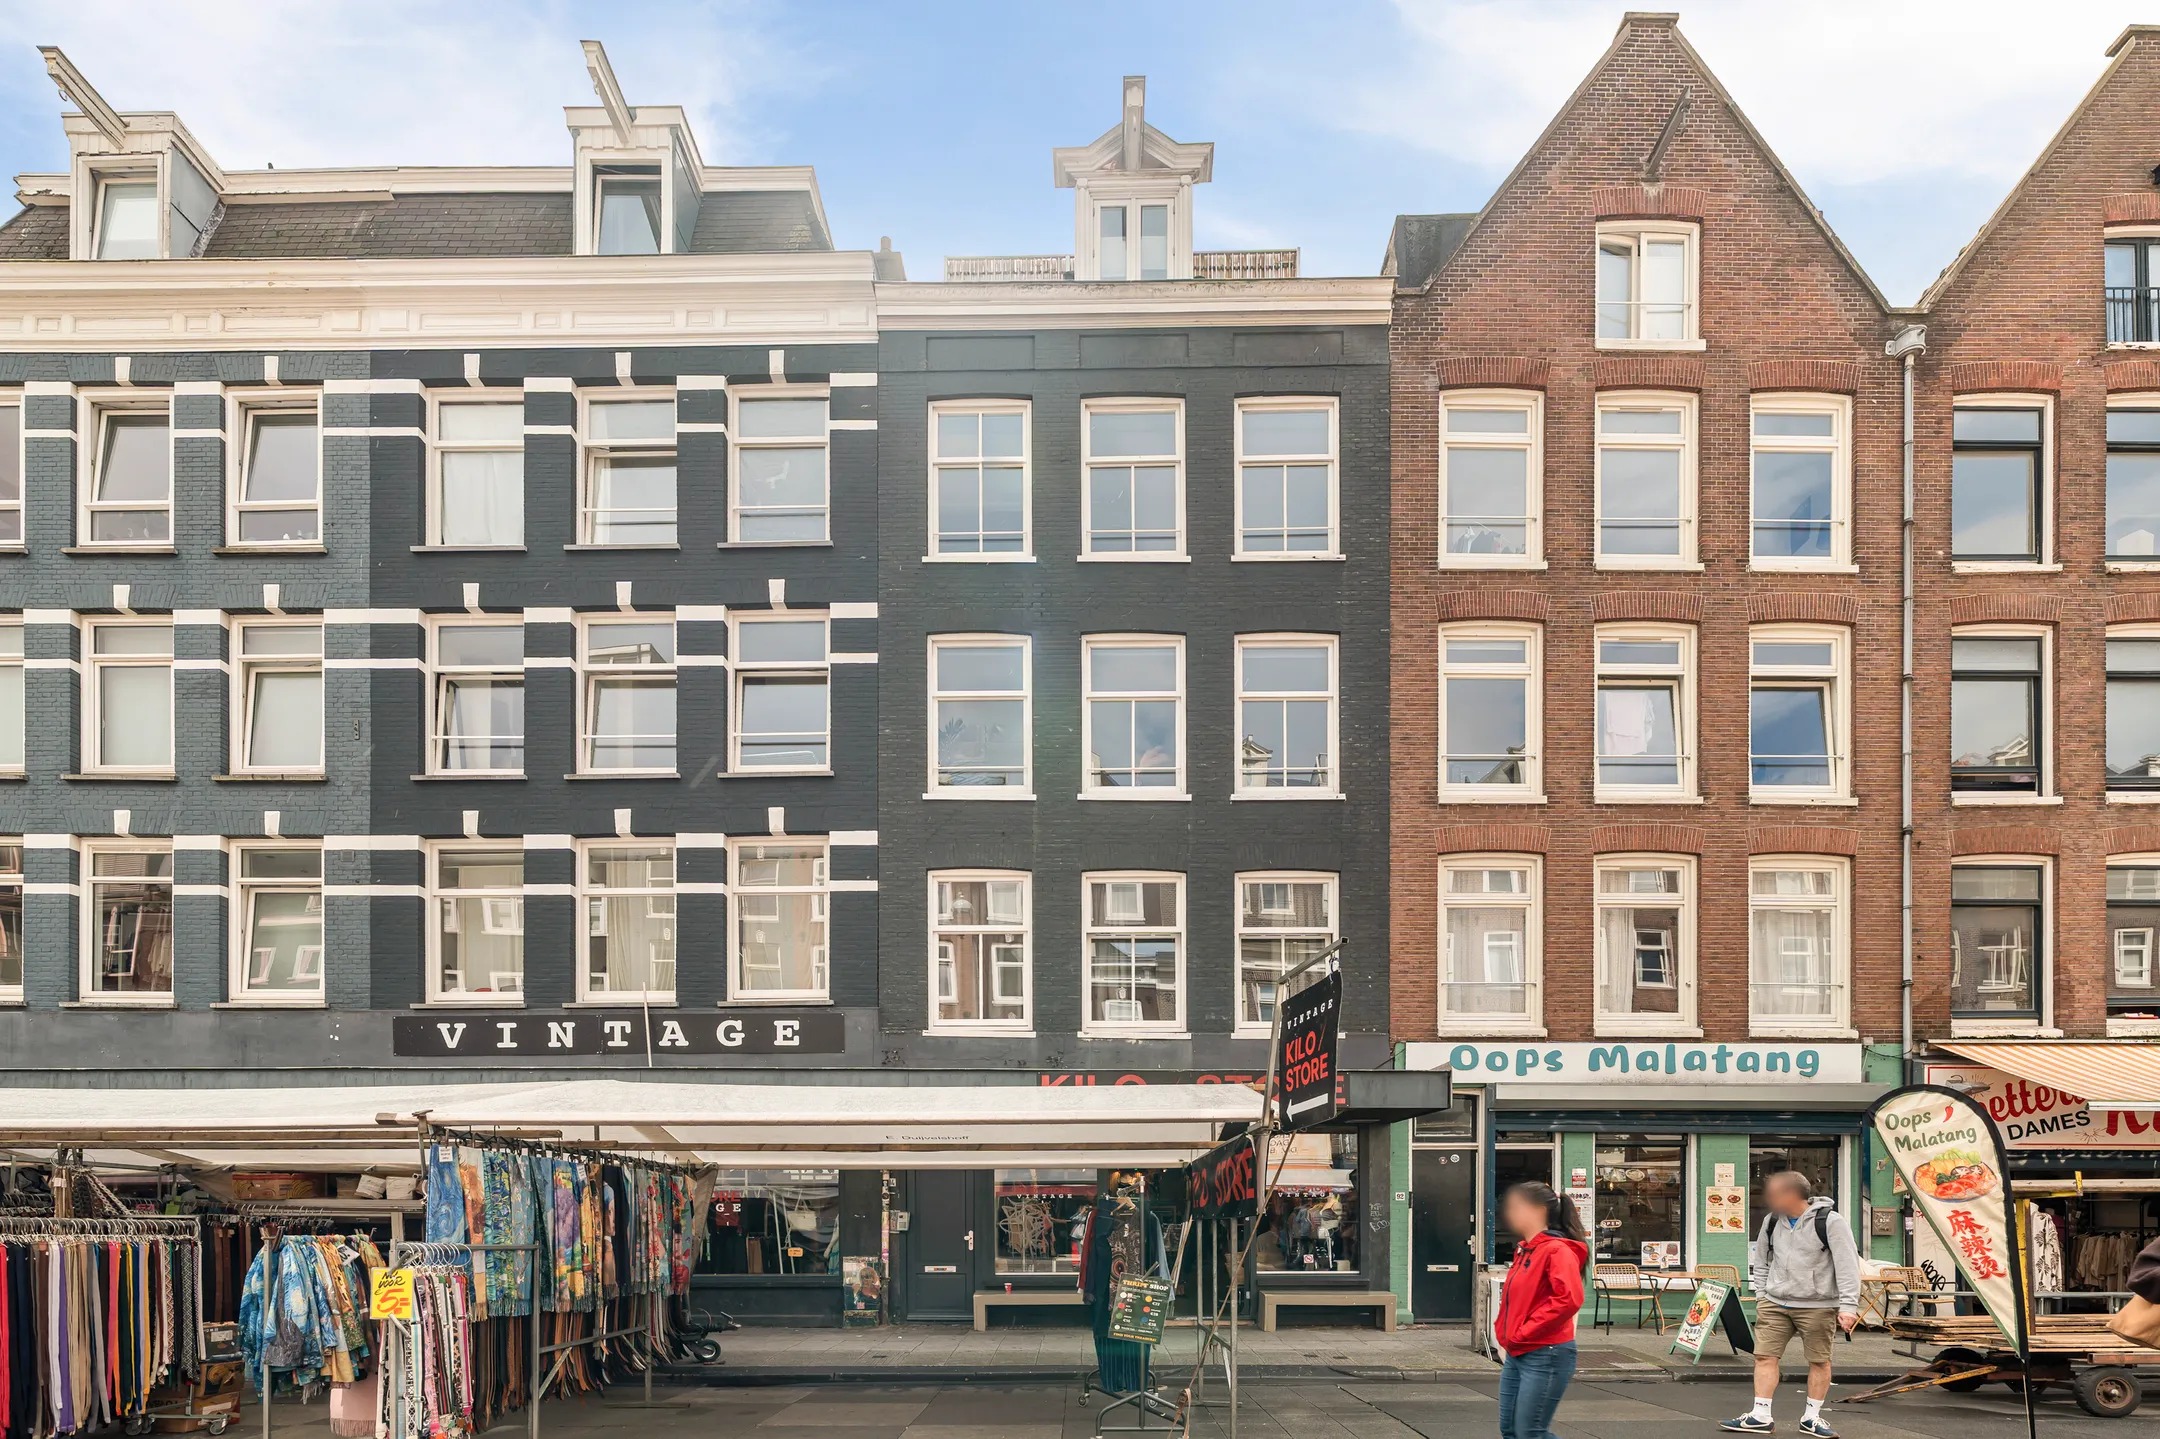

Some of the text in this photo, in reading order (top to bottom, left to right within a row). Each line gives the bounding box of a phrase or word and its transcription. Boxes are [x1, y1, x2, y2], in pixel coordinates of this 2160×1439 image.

[1286, 998, 1333, 1030] VINTAGE
[437, 1020, 800, 1048] VINTAGE
[1285, 1052, 1328, 1093] STORE
[1450, 1043, 1820, 1077] Oops Malatang
[1885, 1111, 1931, 1132] Oops
[2006, 1110, 2091, 1140] DAMES
[1894, 1127, 1977, 1153] Malatang
